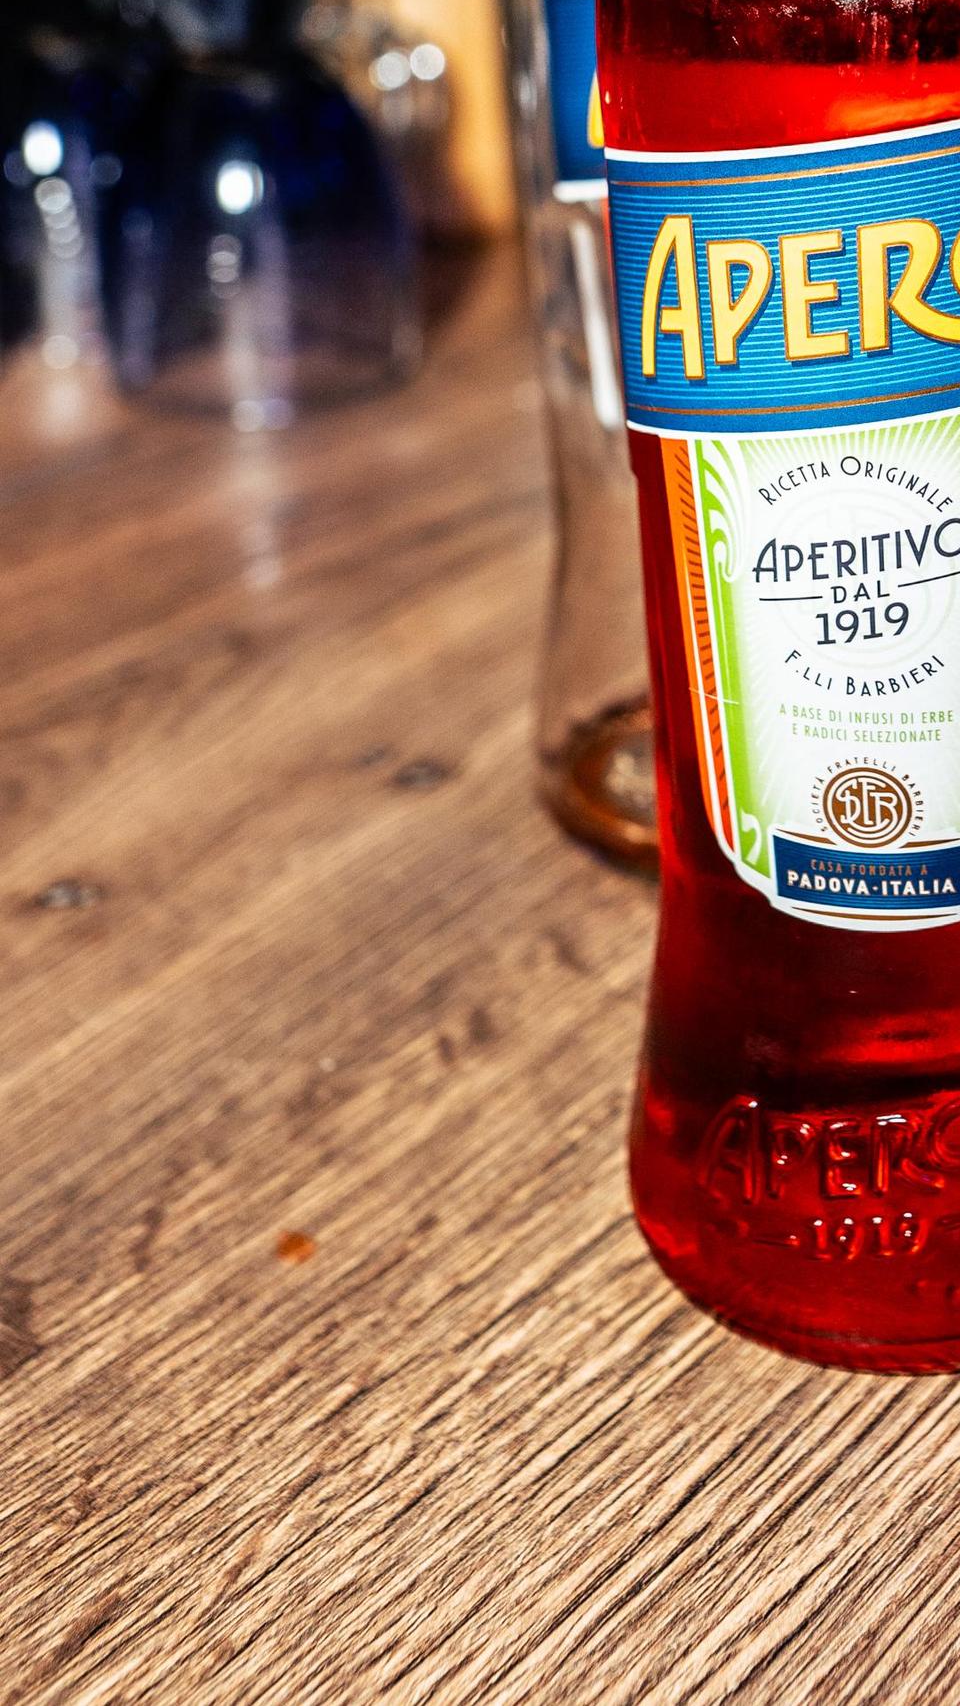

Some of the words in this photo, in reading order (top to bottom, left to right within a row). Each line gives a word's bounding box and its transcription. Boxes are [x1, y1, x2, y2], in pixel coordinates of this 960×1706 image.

[758, 461, 831, 505] RICETTA
[840, 455, 953, 513] ORIGINALE
[831, 580, 890, 604] DAL
[816, 602, 909, 646] 1919
[784, 649, 832, 691] F.LLI
[846, 655, 945, 697] BARBIERI
[779, 703, 787, 715] A
[792, 705, 822, 721] BASE
[829, 709, 842, 723] DI
[849, 711, 894, 725] INFUSI
[901, 712, 914, 725] DI
[921, 710, 953, 724] ERBE
[792, 723, 798, 735] E
[804, 725, 848, 741] RADICI
[854, 729, 941, 743] SELEZIONATE
[827, 756, 897, 774] FRATELLI
[901, 774, 924, 837] BARBIERI
[810, 858, 843, 874] CASA
